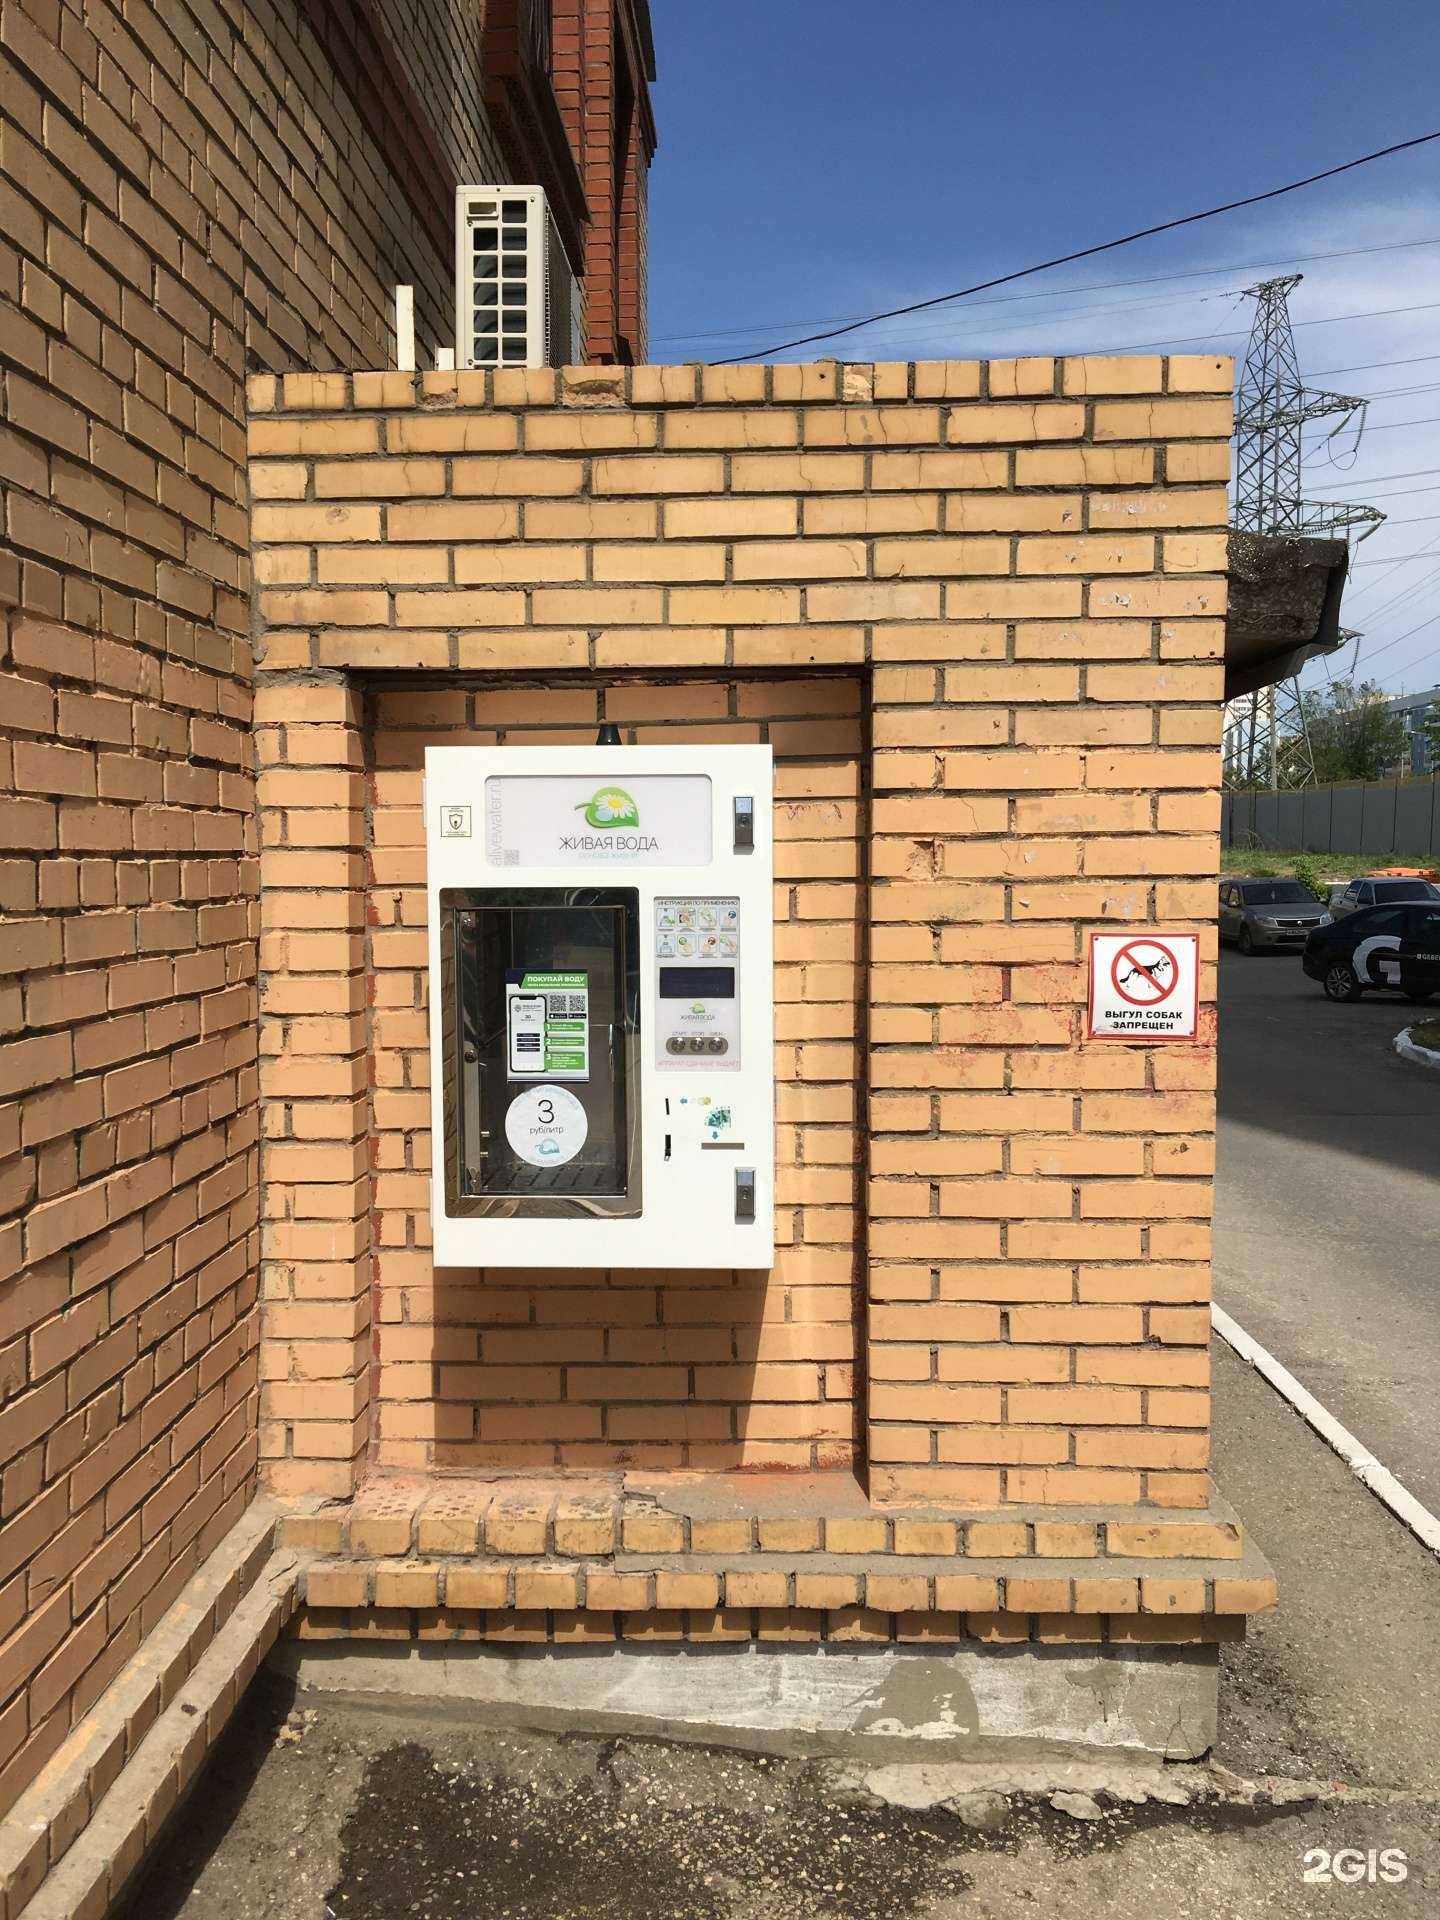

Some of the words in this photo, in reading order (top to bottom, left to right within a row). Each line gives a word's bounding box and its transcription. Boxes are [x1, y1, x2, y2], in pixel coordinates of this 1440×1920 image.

[559, 836, 613, 850] ЖИВАЯ
[616, 836, 659, 852] ВОДА
[527, 975, 563, 983] ПОКУПАЙ
[1105, 1010, 1143, 1019] ВЫГУЛ
[1146, 1010, 1183, 1019] СОБАК
[1112, 1021, 1174, 1030] ЗАПРЕЩЕН
[538, 1099, 555, 1124] 3
